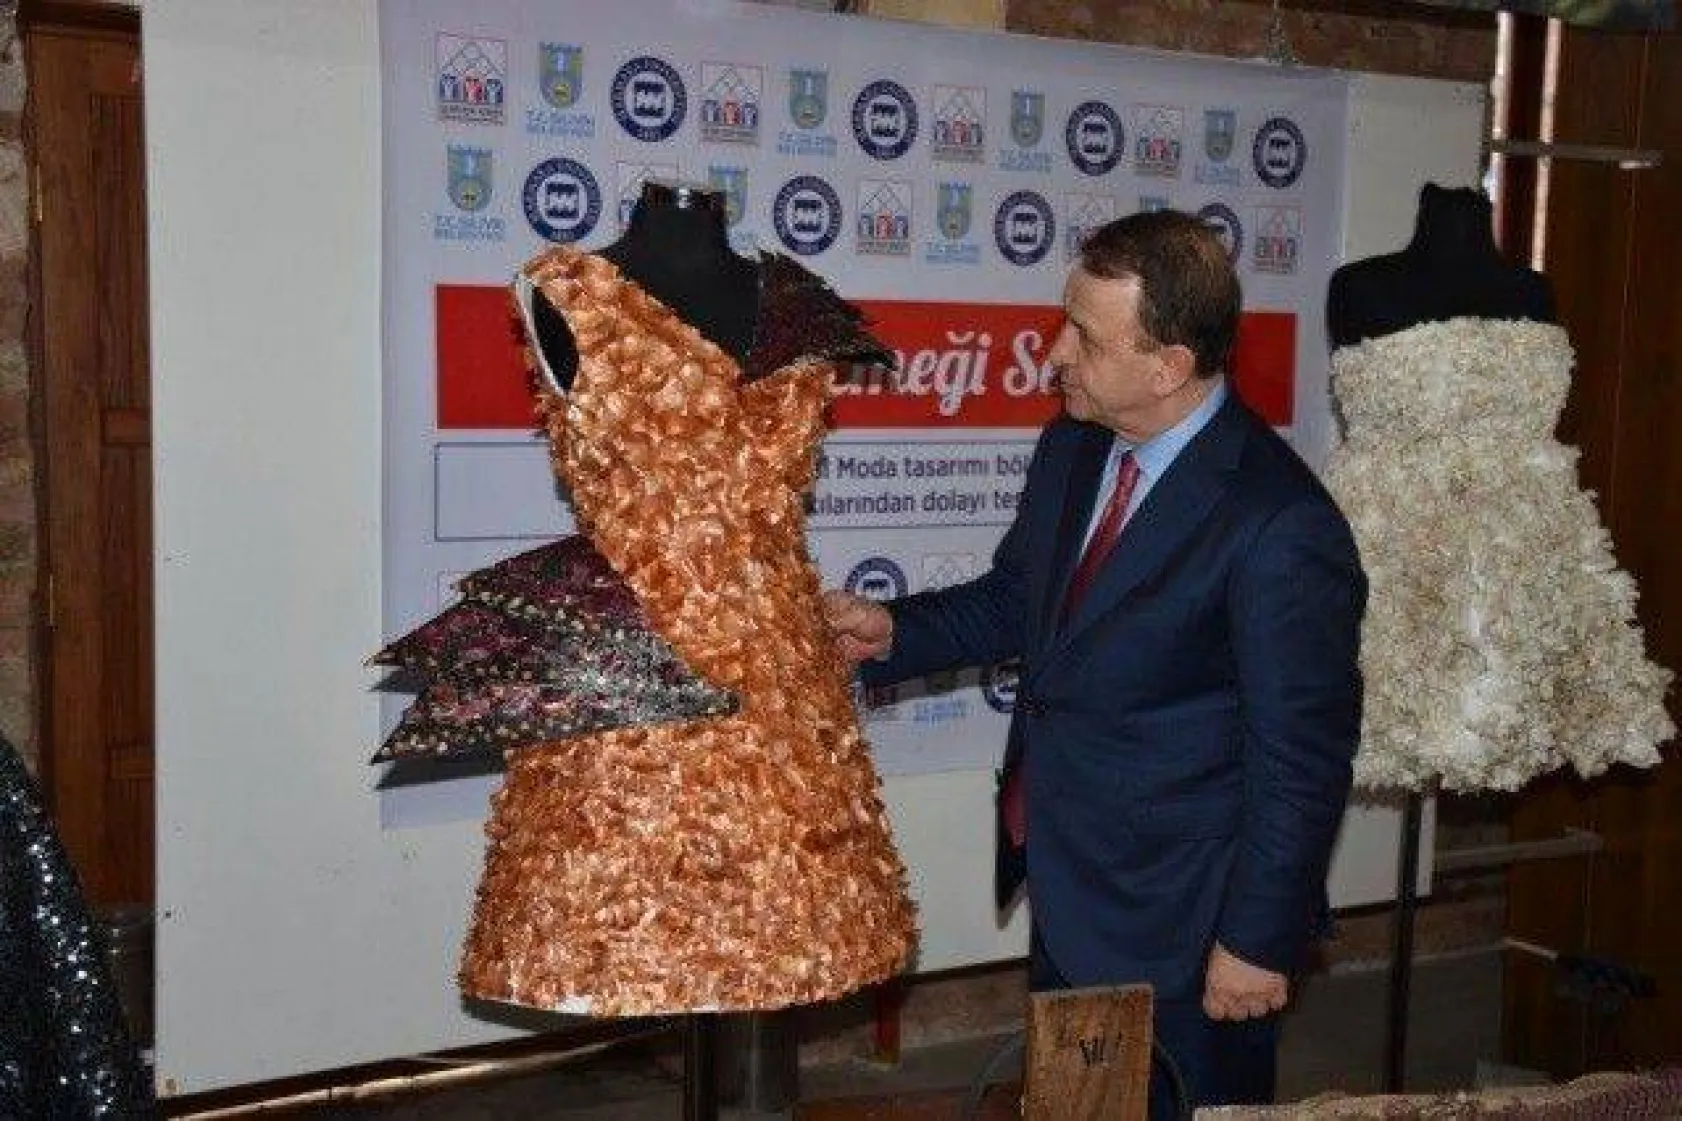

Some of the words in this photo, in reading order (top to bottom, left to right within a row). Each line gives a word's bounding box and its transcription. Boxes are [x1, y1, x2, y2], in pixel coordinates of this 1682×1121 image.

[836, 455, 899, 479] Moda
[904, 455, 990, 478] tasarımı
[922, 490, 987, 517] dolayı
